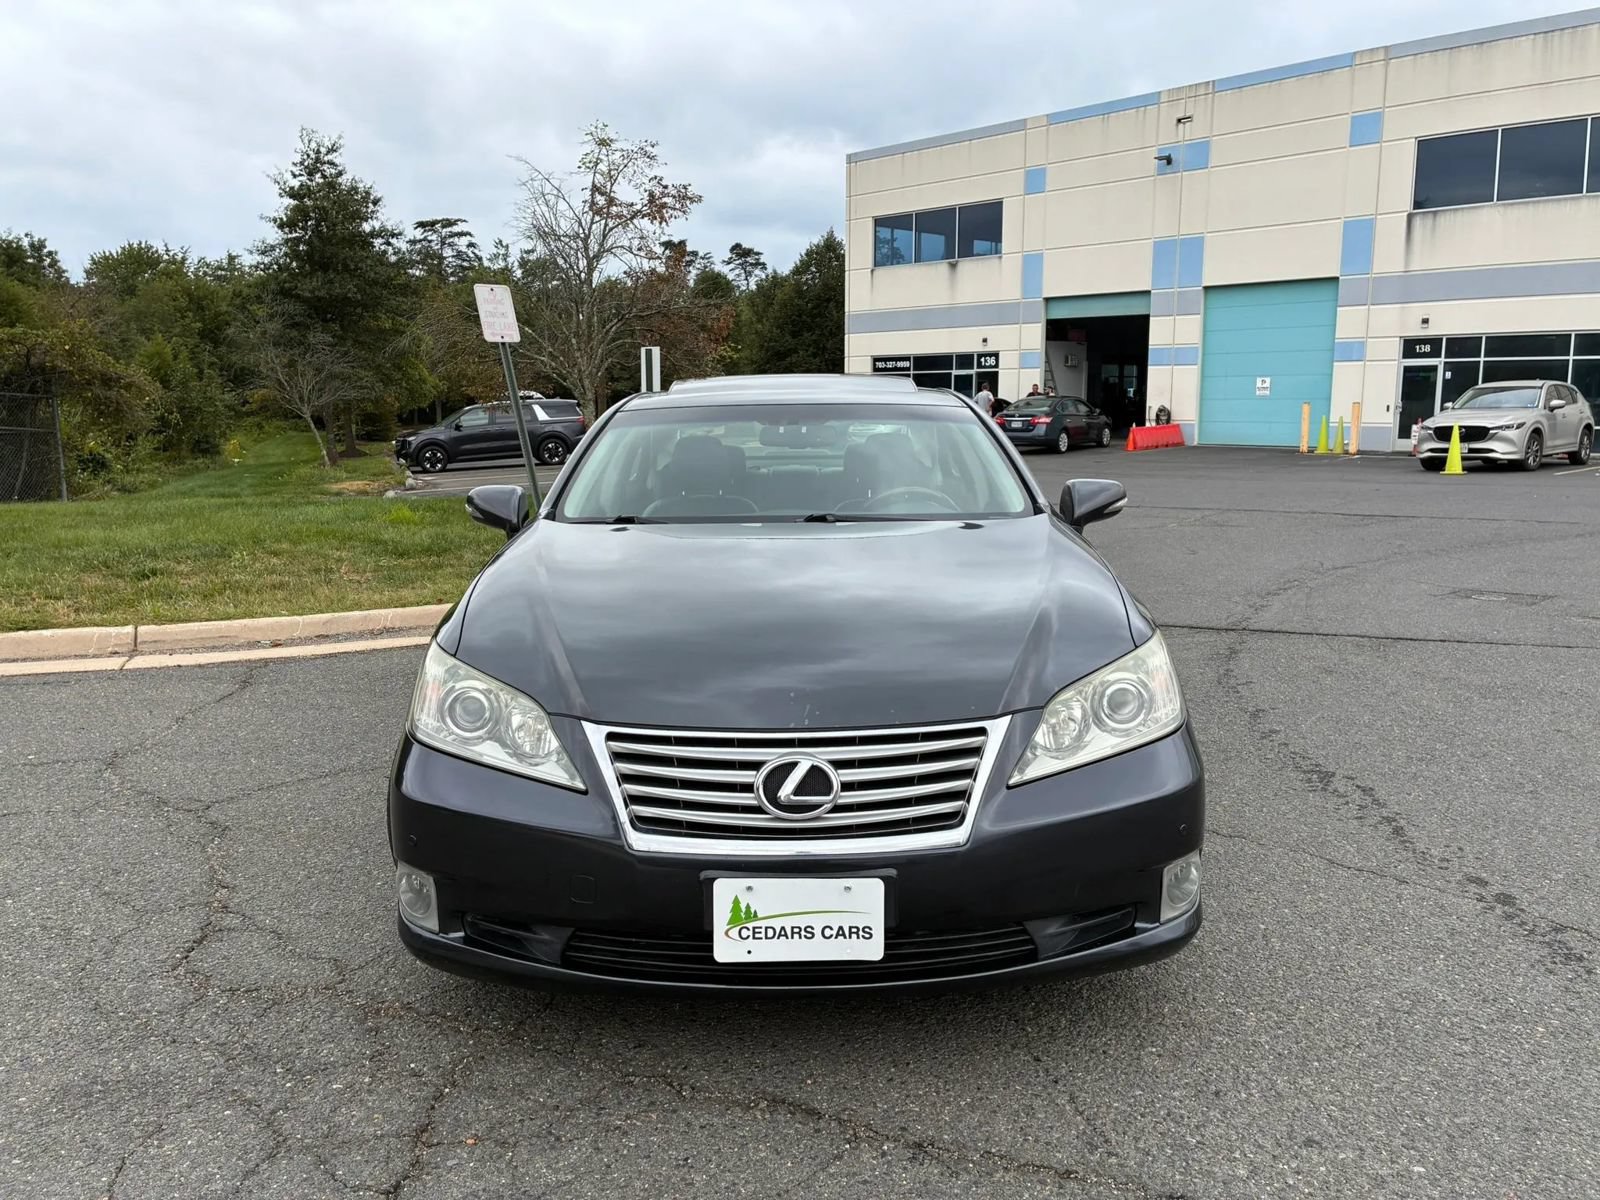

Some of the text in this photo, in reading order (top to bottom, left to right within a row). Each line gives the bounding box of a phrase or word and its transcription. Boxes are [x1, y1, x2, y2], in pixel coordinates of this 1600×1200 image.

[1415, 344, 1431, 352] 138
[980, 356, 996, 366] 136
[738, 925, 873, 940] CEDARS CARS
